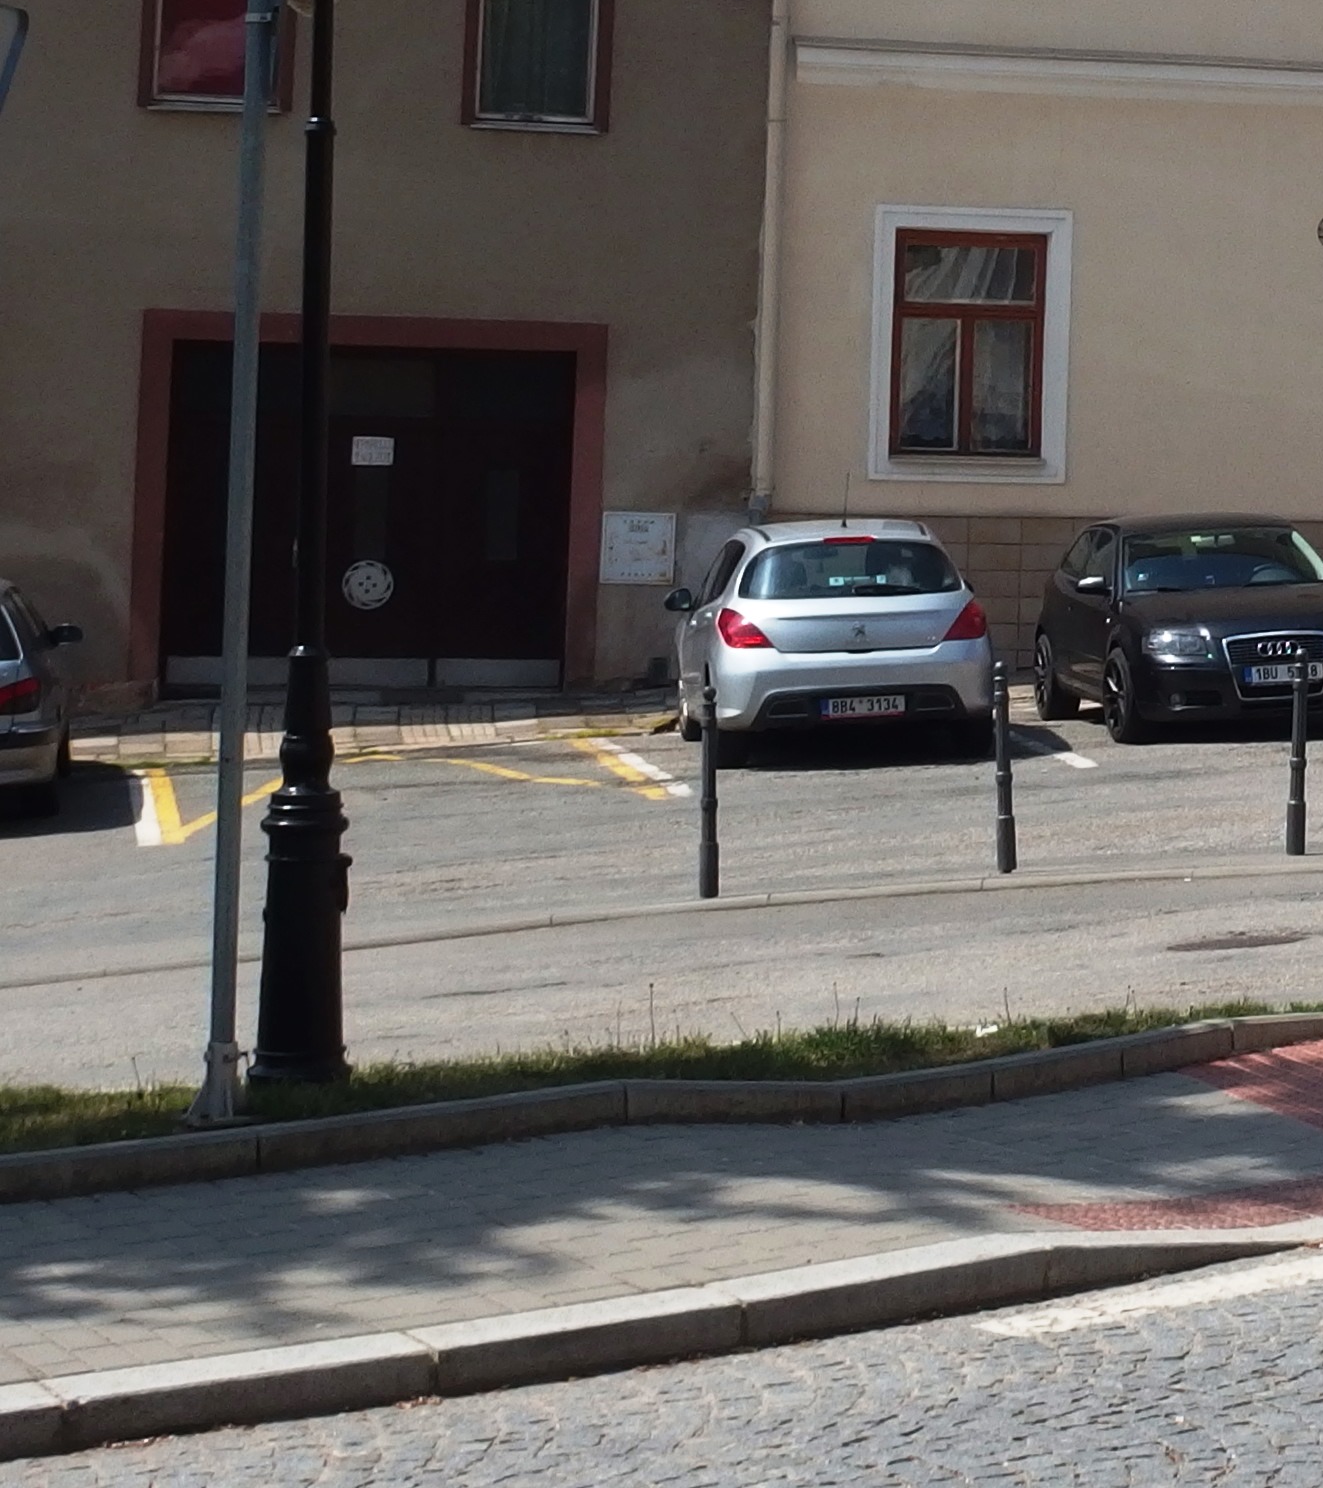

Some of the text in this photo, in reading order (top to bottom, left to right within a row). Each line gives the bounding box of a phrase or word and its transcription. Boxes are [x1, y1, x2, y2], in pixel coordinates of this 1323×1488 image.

[1256, 665, 1318, 680] 1BU 58
[832, 697, 899, 714] 8B4 3134
